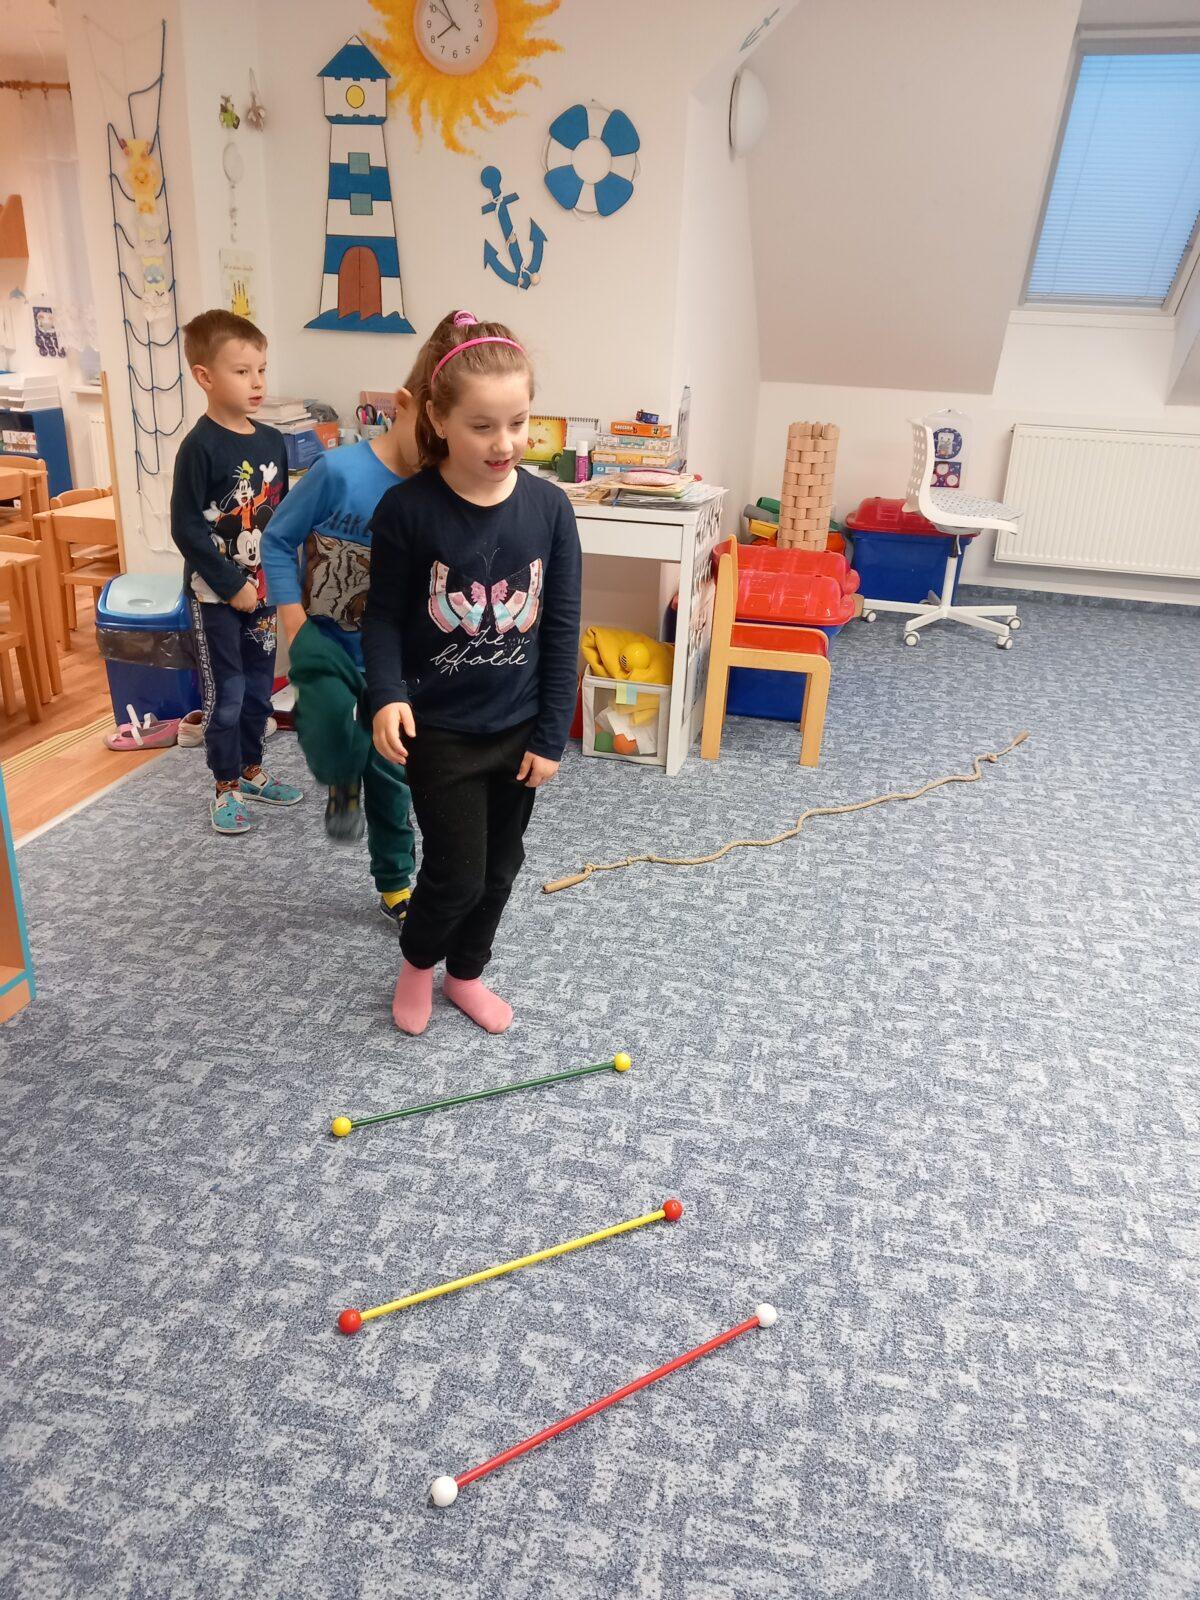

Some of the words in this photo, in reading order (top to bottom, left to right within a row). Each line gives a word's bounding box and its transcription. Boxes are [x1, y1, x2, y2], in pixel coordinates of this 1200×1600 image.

[474, 3, 479, 12] 2
[427, 20, 431, 28] 9
[477, 19, 482, 28] 3
[431, 35, 435, 43] 8
[474, 34, 479, 42] 4
[440, 45, 445, 54] 7
[465, 46, 470, 54] 5
[453, 50, 458, 58] 6
[468, 625, 505, 647] the
